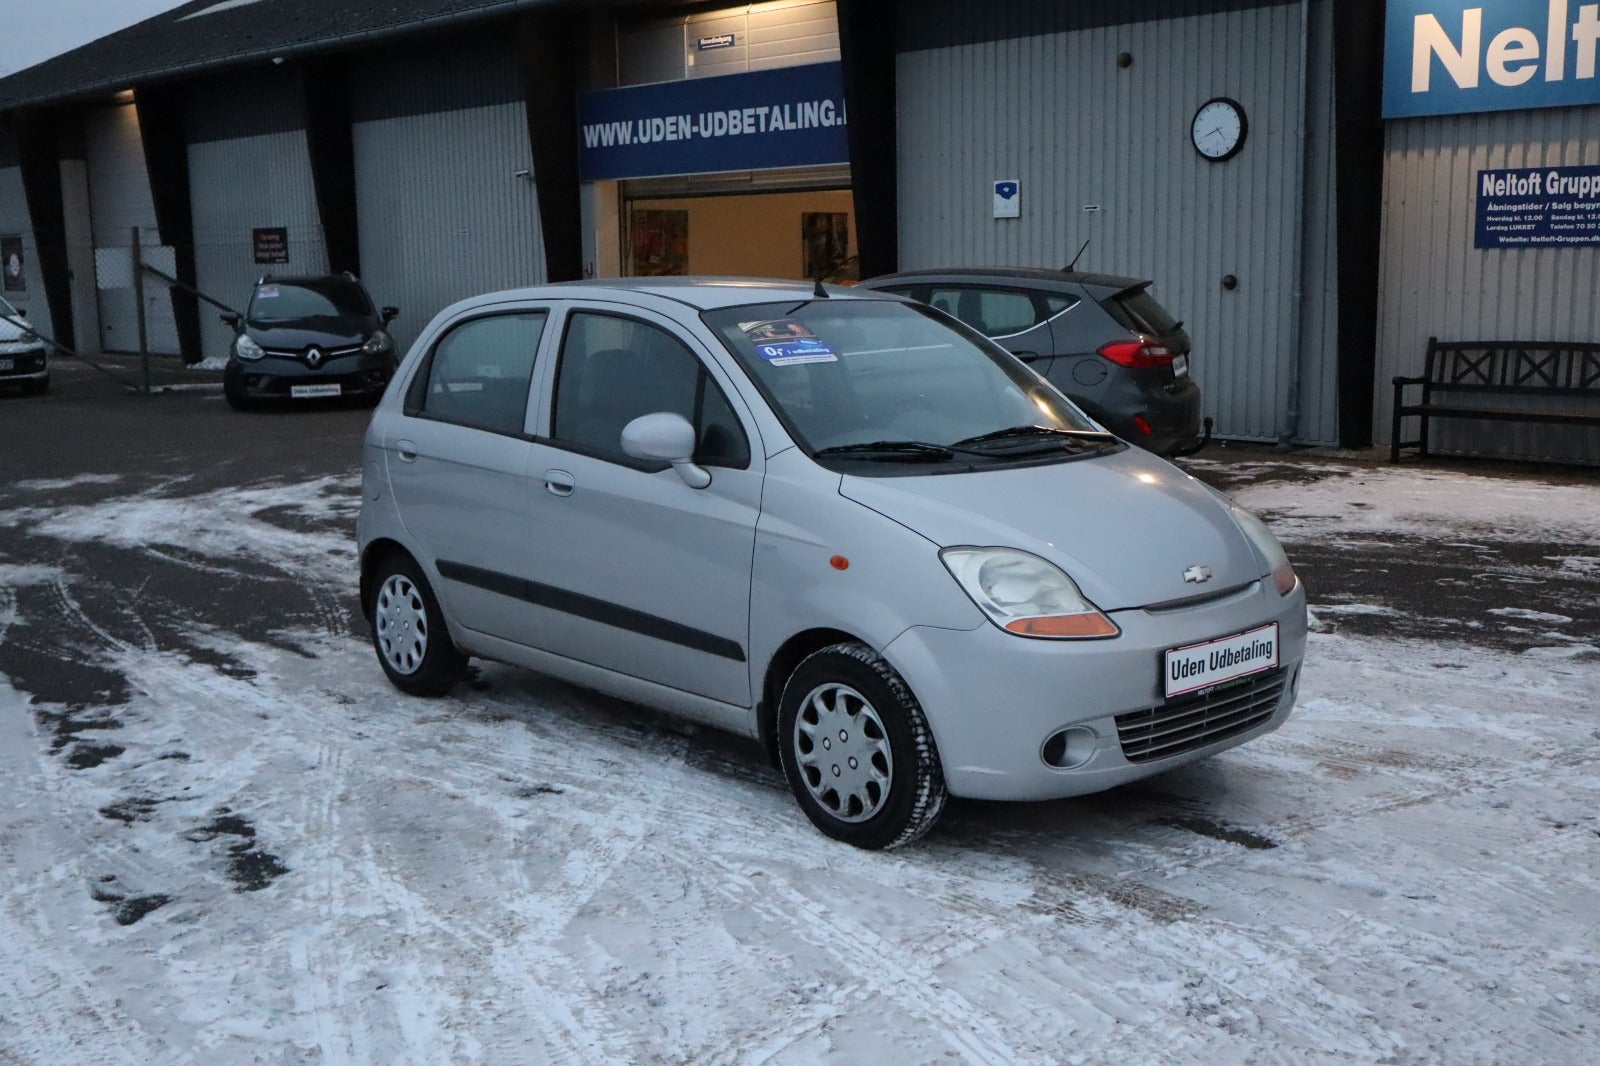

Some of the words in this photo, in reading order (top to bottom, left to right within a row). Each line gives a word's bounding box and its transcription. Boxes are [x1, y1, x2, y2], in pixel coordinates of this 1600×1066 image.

[583, 98, 847, 148] WWW.UDEN-UDBETALING.
[1482, 173, 1541, 196] Neltoft
[1487, 201, 1543, 212] Åbningstider
[1551, 202, 1572, 211] Salg
[1171, 658, 1205, 680] Uden
[1209, 640, 1272, 671] Udbetaling
